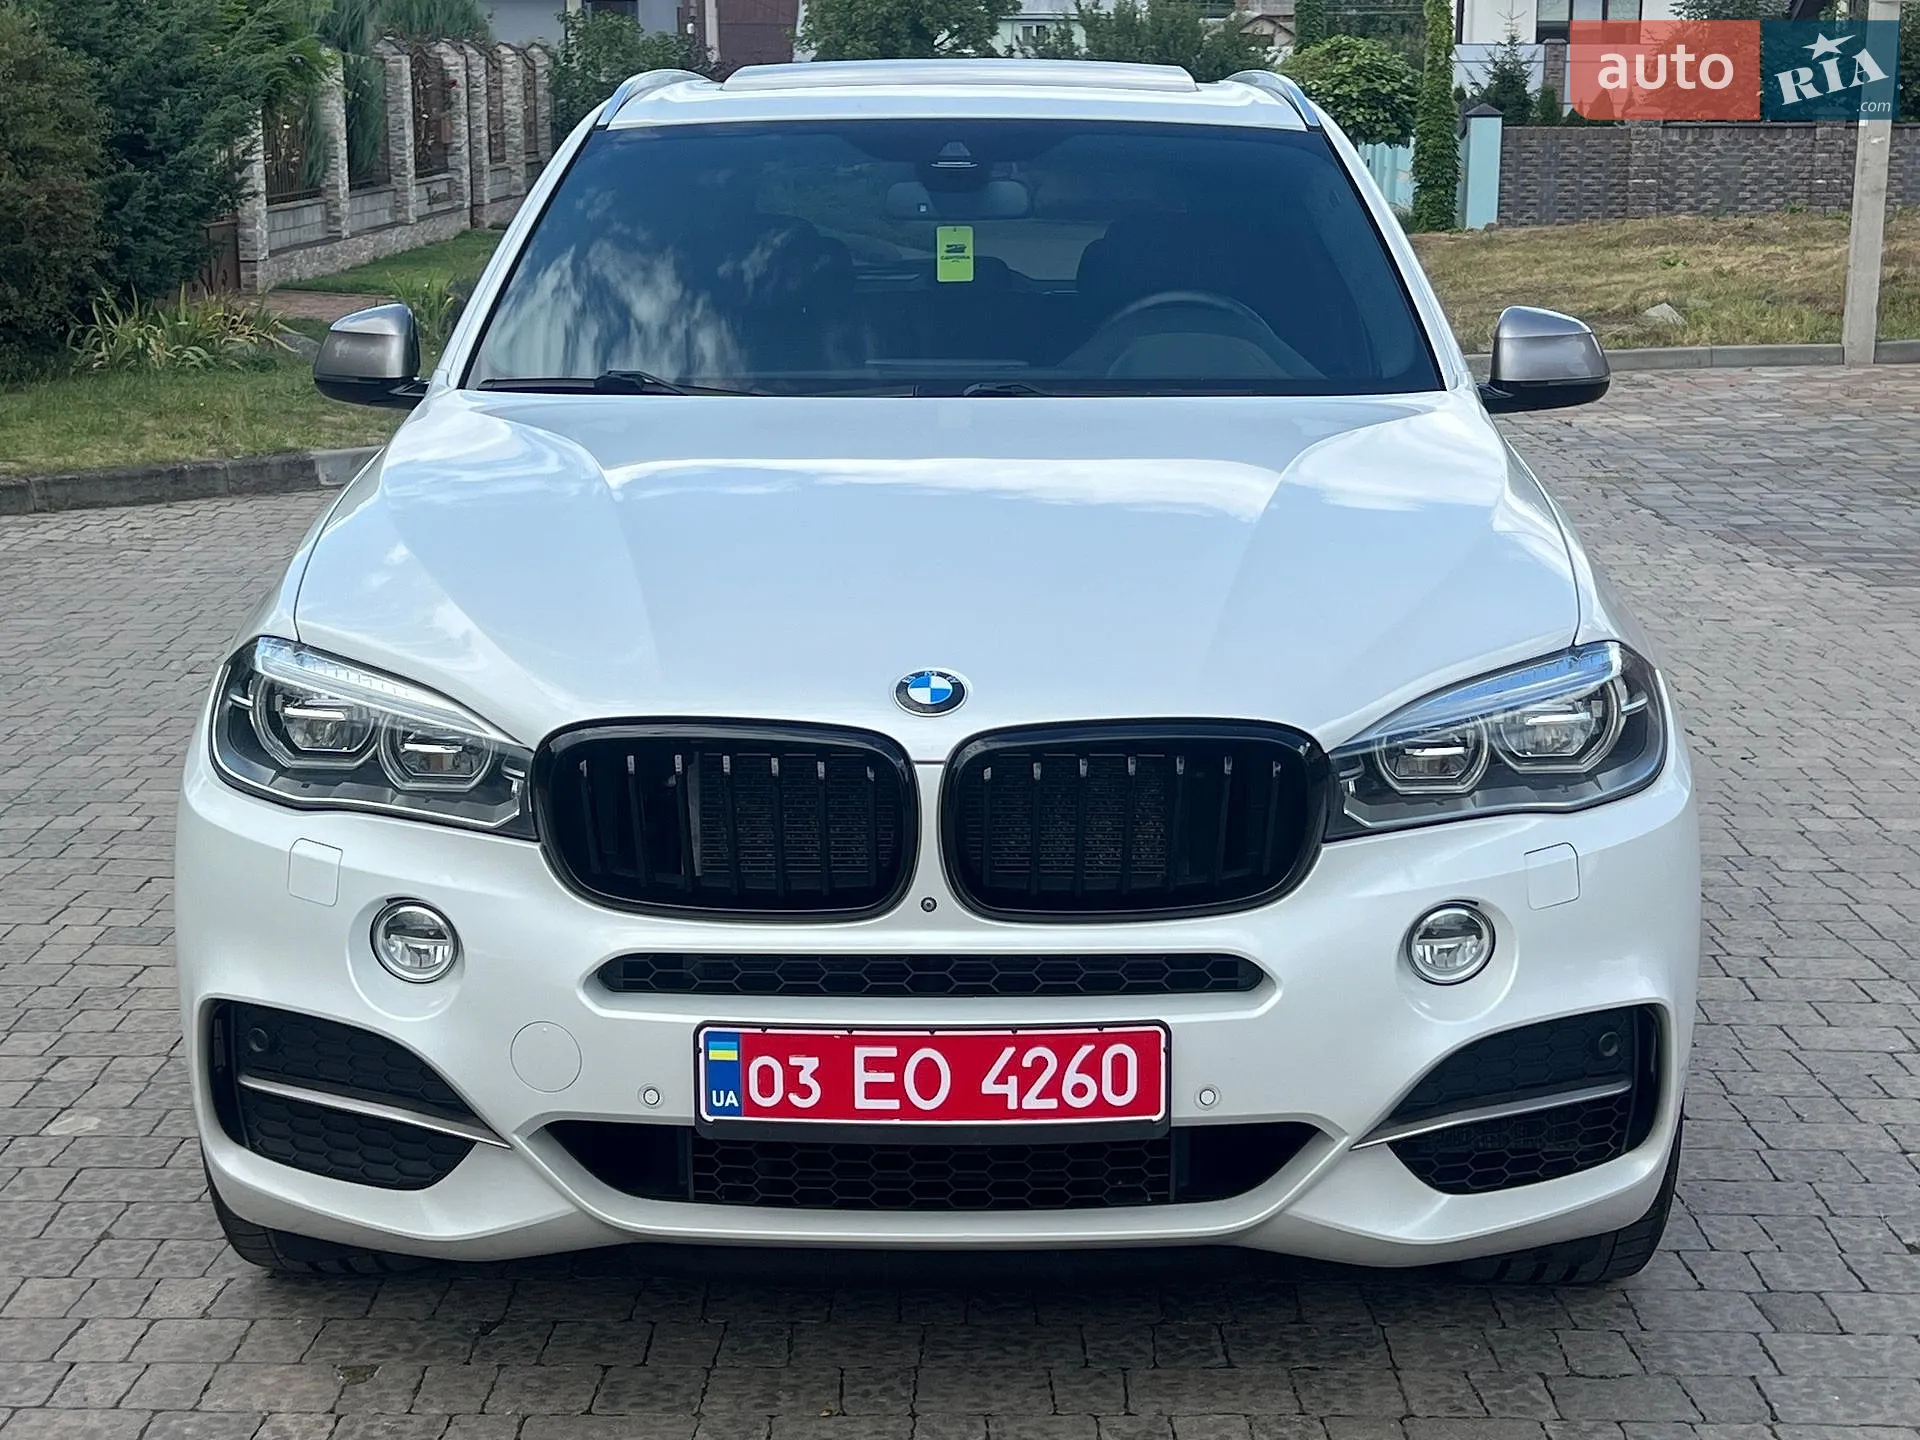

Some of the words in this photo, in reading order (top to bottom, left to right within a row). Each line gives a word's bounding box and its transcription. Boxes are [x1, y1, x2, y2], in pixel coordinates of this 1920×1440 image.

[748, 1056, 822, 1108] 03
[853, 1046, 951, 1110] EO
[981, 1044, 1138, 1109] 4260
[712, 1090, 739, 1107] UA
